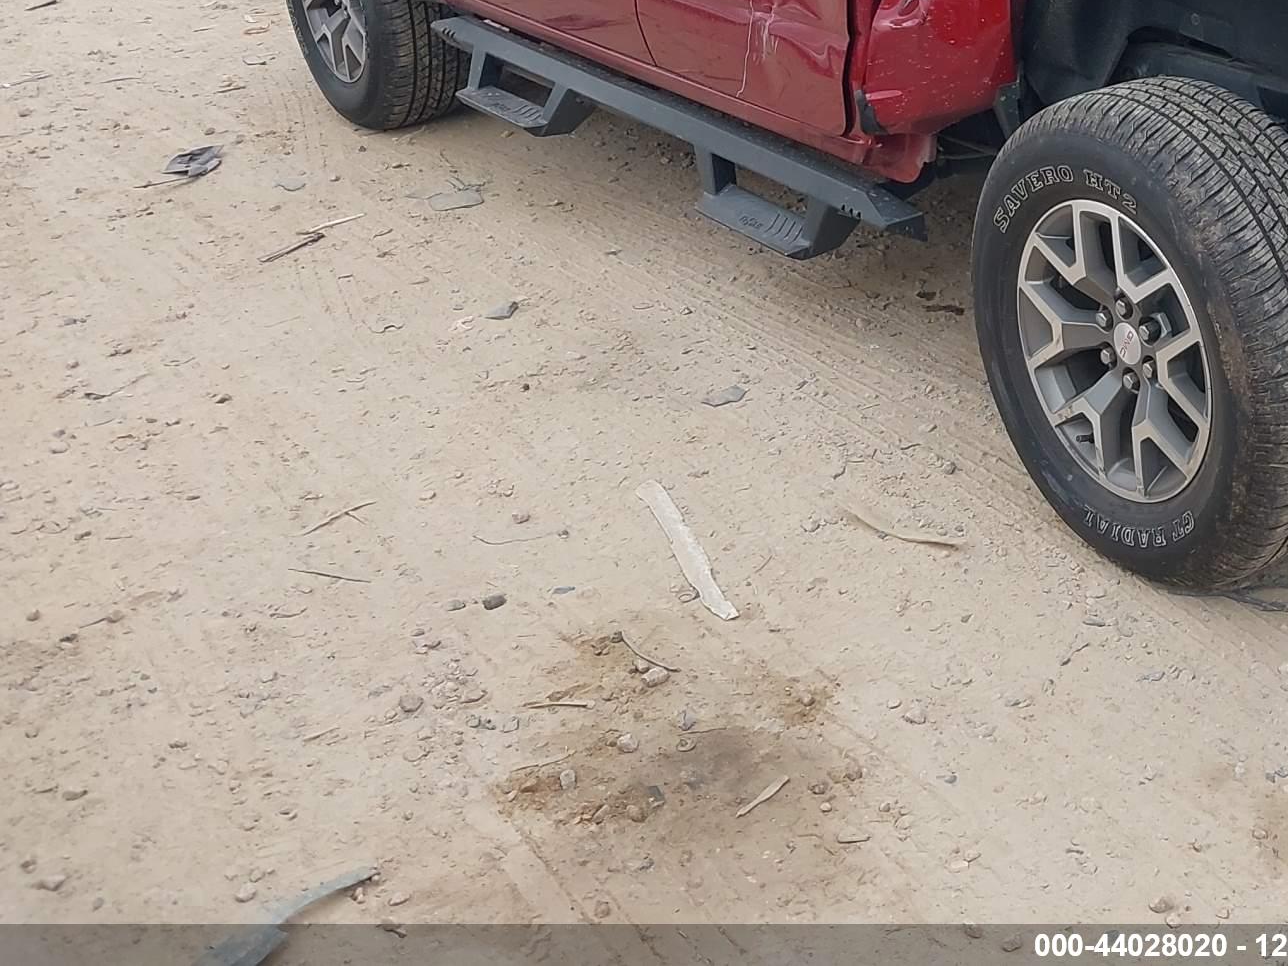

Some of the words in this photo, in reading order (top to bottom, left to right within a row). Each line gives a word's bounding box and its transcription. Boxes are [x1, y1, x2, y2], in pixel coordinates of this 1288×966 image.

[993, 165, 1074, 234] SAVERO
[1083, 168, 1137, 215] HT2
[1083, 504, 1167, 548] RADIAL
[1172, 510, 1195, 542] GT
